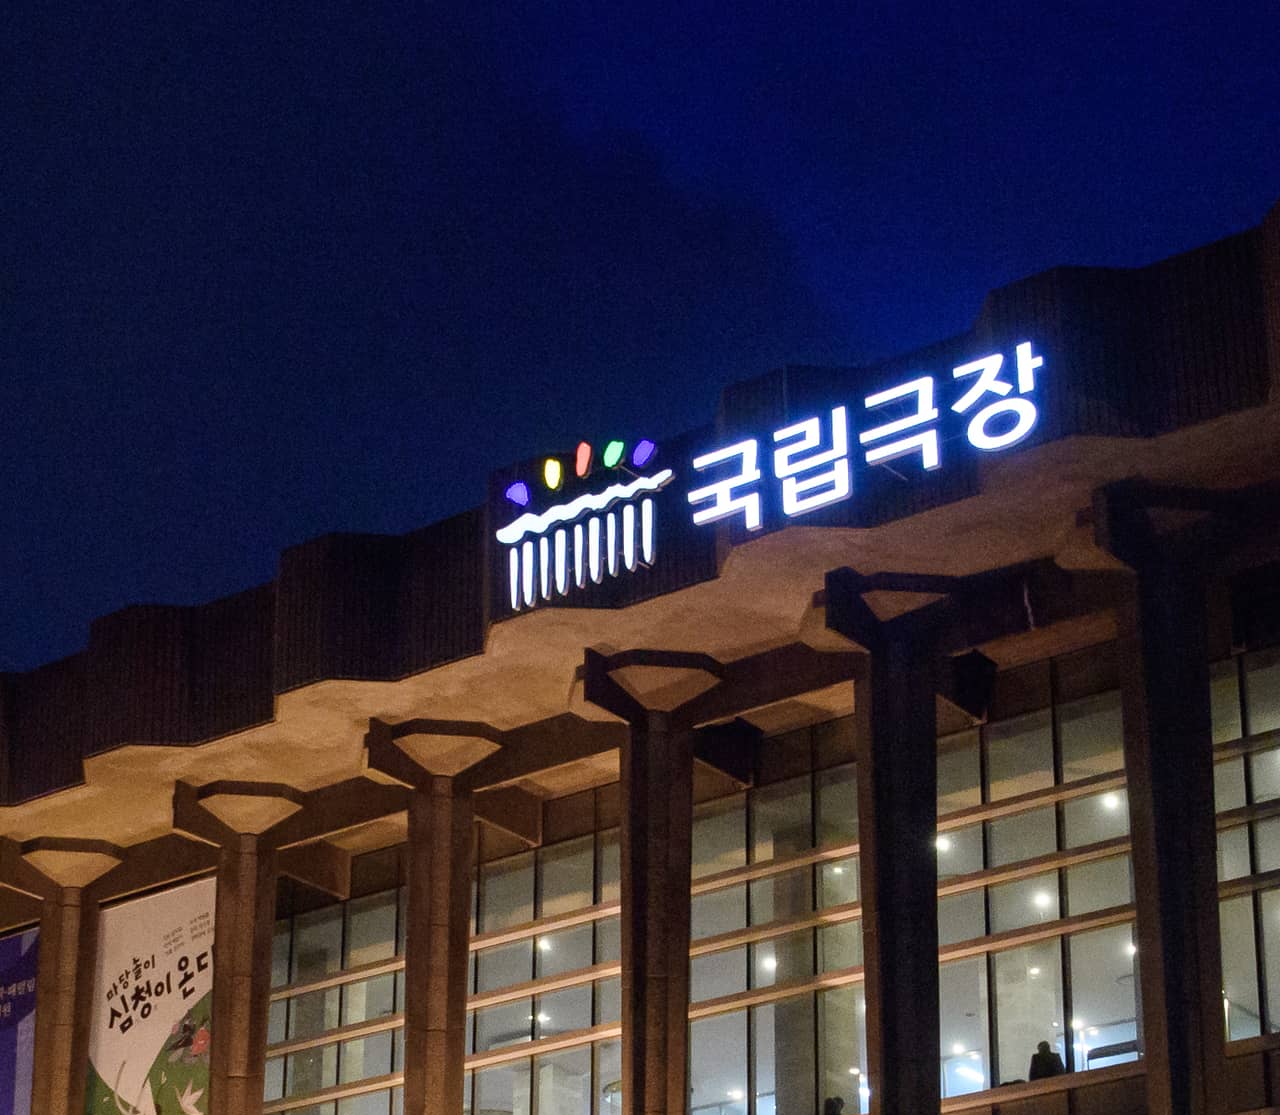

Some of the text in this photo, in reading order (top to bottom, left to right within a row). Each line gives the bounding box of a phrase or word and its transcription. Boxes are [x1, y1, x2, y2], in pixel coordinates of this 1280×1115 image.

[687, 341, 1044, 531] 국립극장
[106, 953, 156, 1001] 마당놀이
[108, 970, 173, 1035] 심청이
